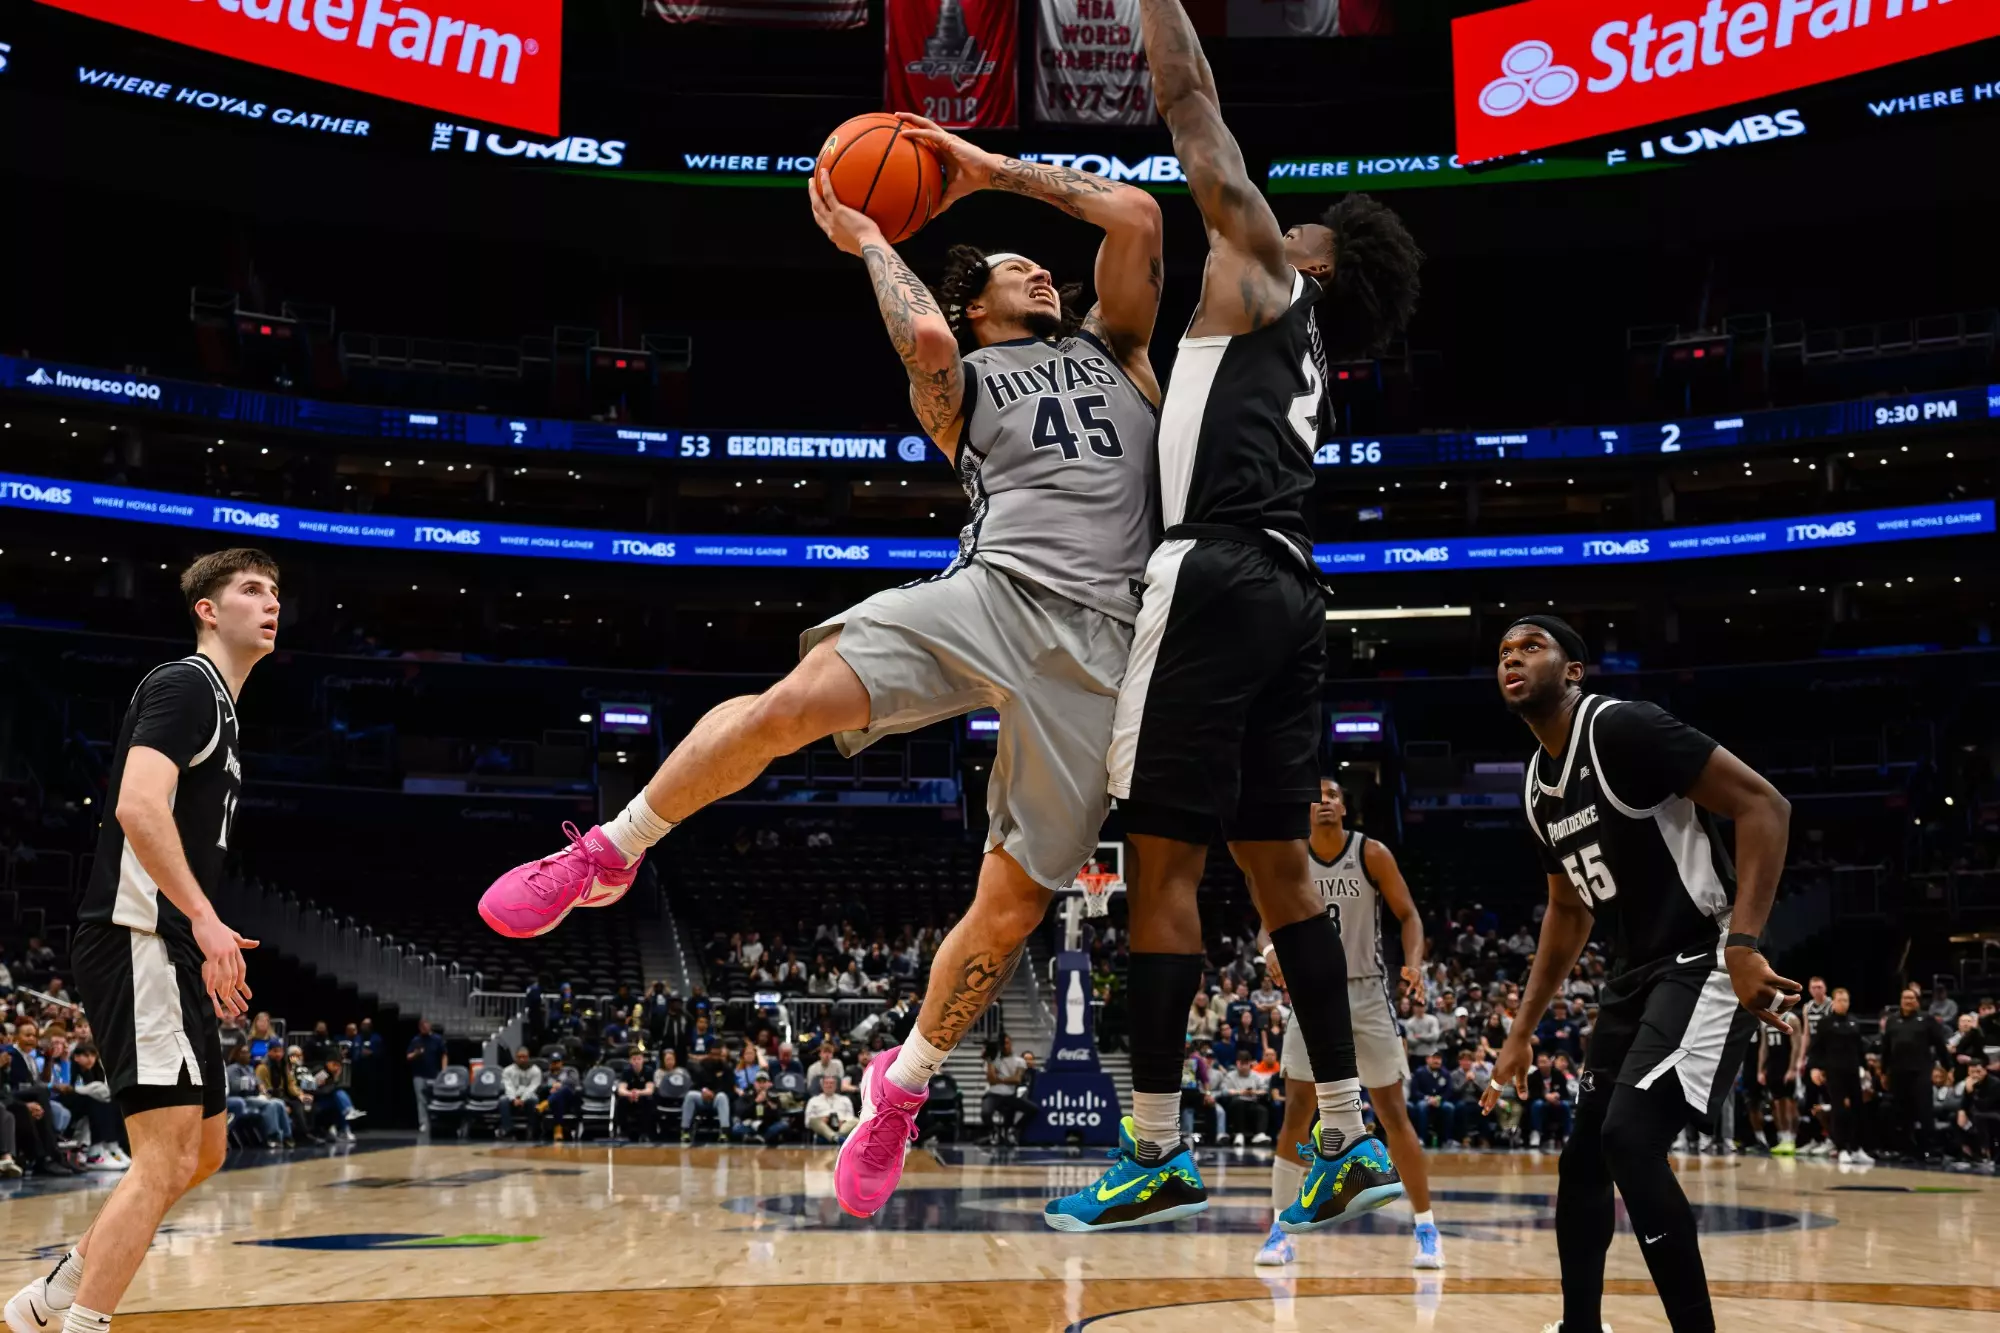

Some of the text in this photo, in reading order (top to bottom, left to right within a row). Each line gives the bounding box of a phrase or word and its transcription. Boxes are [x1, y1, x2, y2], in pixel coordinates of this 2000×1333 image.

[195, 0, 522, 84] eFarm
[1061, 24, 1131, 45] WORLD
[1041, 51, 1149, 72] CHAMPION
[80, 68, 369, 135] WHERE HOYAS GATHER
[924, 97, 977, 123] 2018
[1869, 88, 1963, 116] WHERE
[431, 123, 453, 150] THE
[685, 154, 768, 170] WHERE
[1041, 154, 1187, 182] TOMB
[1268, 160, 1349, 177] WHERE
[1357, 156, 1439, 174] HOYAS
[56, 371, 123, 394] Invesco
[983, 356, 1119, 412] HOYAS
[1876, 400, 1957, 424] 9:30 PM
[514, 432, 522, 443] 2
[1030, 395, 1125, 461] 45
[1661, 424, 1680, 452] 2
[681, 436, 710, 457] 53
[728, 437, 885, 457] GEORGETOWN
[1351, 442, 1381, 463] 56
[8, 482, 72, 504] TOMBS
[222, 507, 279, 529] TOMBS
[423, 527, 480, 545] TOMBS
[1795, 521, 1856, 540] TOMBS
[620, 540, 675, 557] TOMBS
[814, 545, 869, 560] TOMBS
[1392, 547, 1448, 562] TOMBS
[1591, 539, 1649, 555] TOMBS
[1560, 843, 1617, 909] 55
[1314, 878, 1361, 898] YAS
